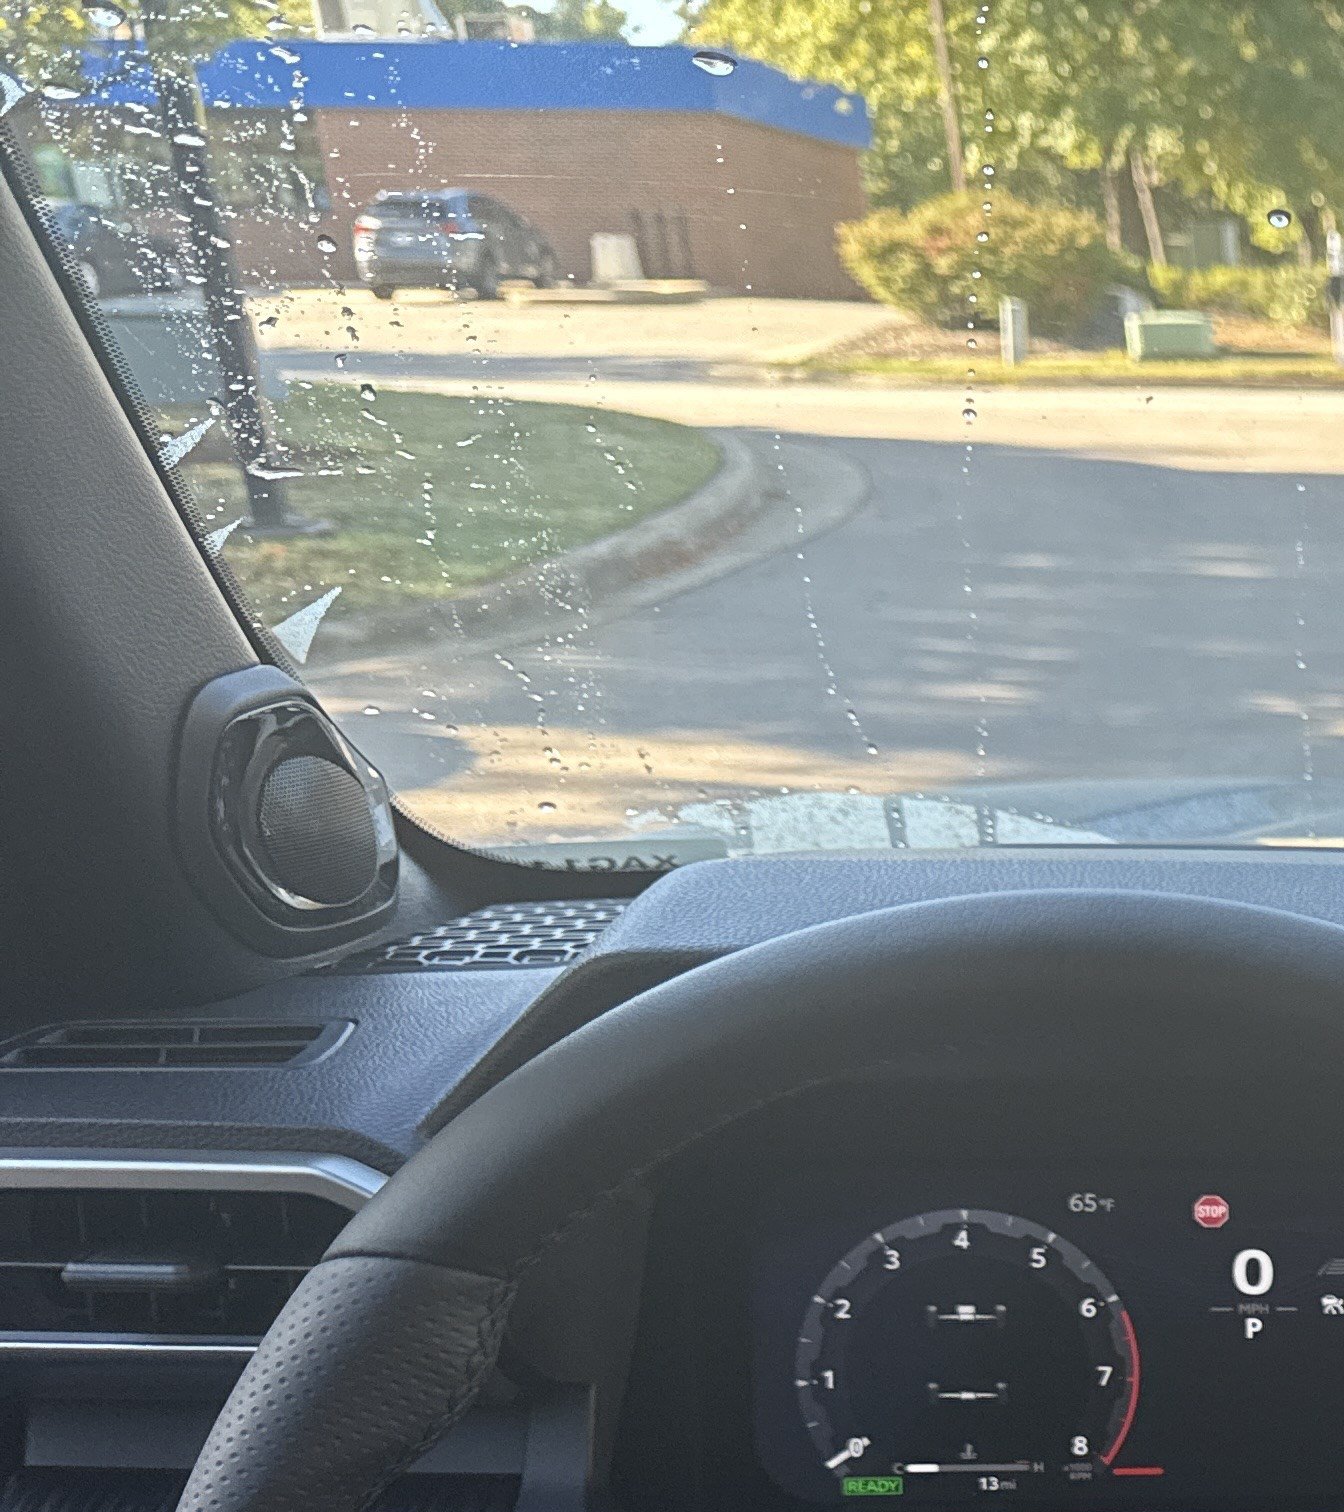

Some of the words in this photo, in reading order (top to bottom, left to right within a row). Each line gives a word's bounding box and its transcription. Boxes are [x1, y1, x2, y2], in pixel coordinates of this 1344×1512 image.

[1197, 1205, 1226, 1218] STOP
[953, 1230, 970, 1250] 4
[883, 1250, 901, 1270] 3
[1029, 1248, 1047, 1268] 5
[1232, 1249, 1274, 1296] 0
[832, 1299, 851, 1320] 2
[1080, 1298, 1097, 1318] 6
[1237, 1303, 1270, 1314] MPH
[1245, 1317, 1263, 1340] P
[823, 1370, 835, 1390] 1
[1097, 1366, 1113, 1386] 7
[1071, 1435, 1089, 1456] 8
[848, 1480, 899, 1493] READY
